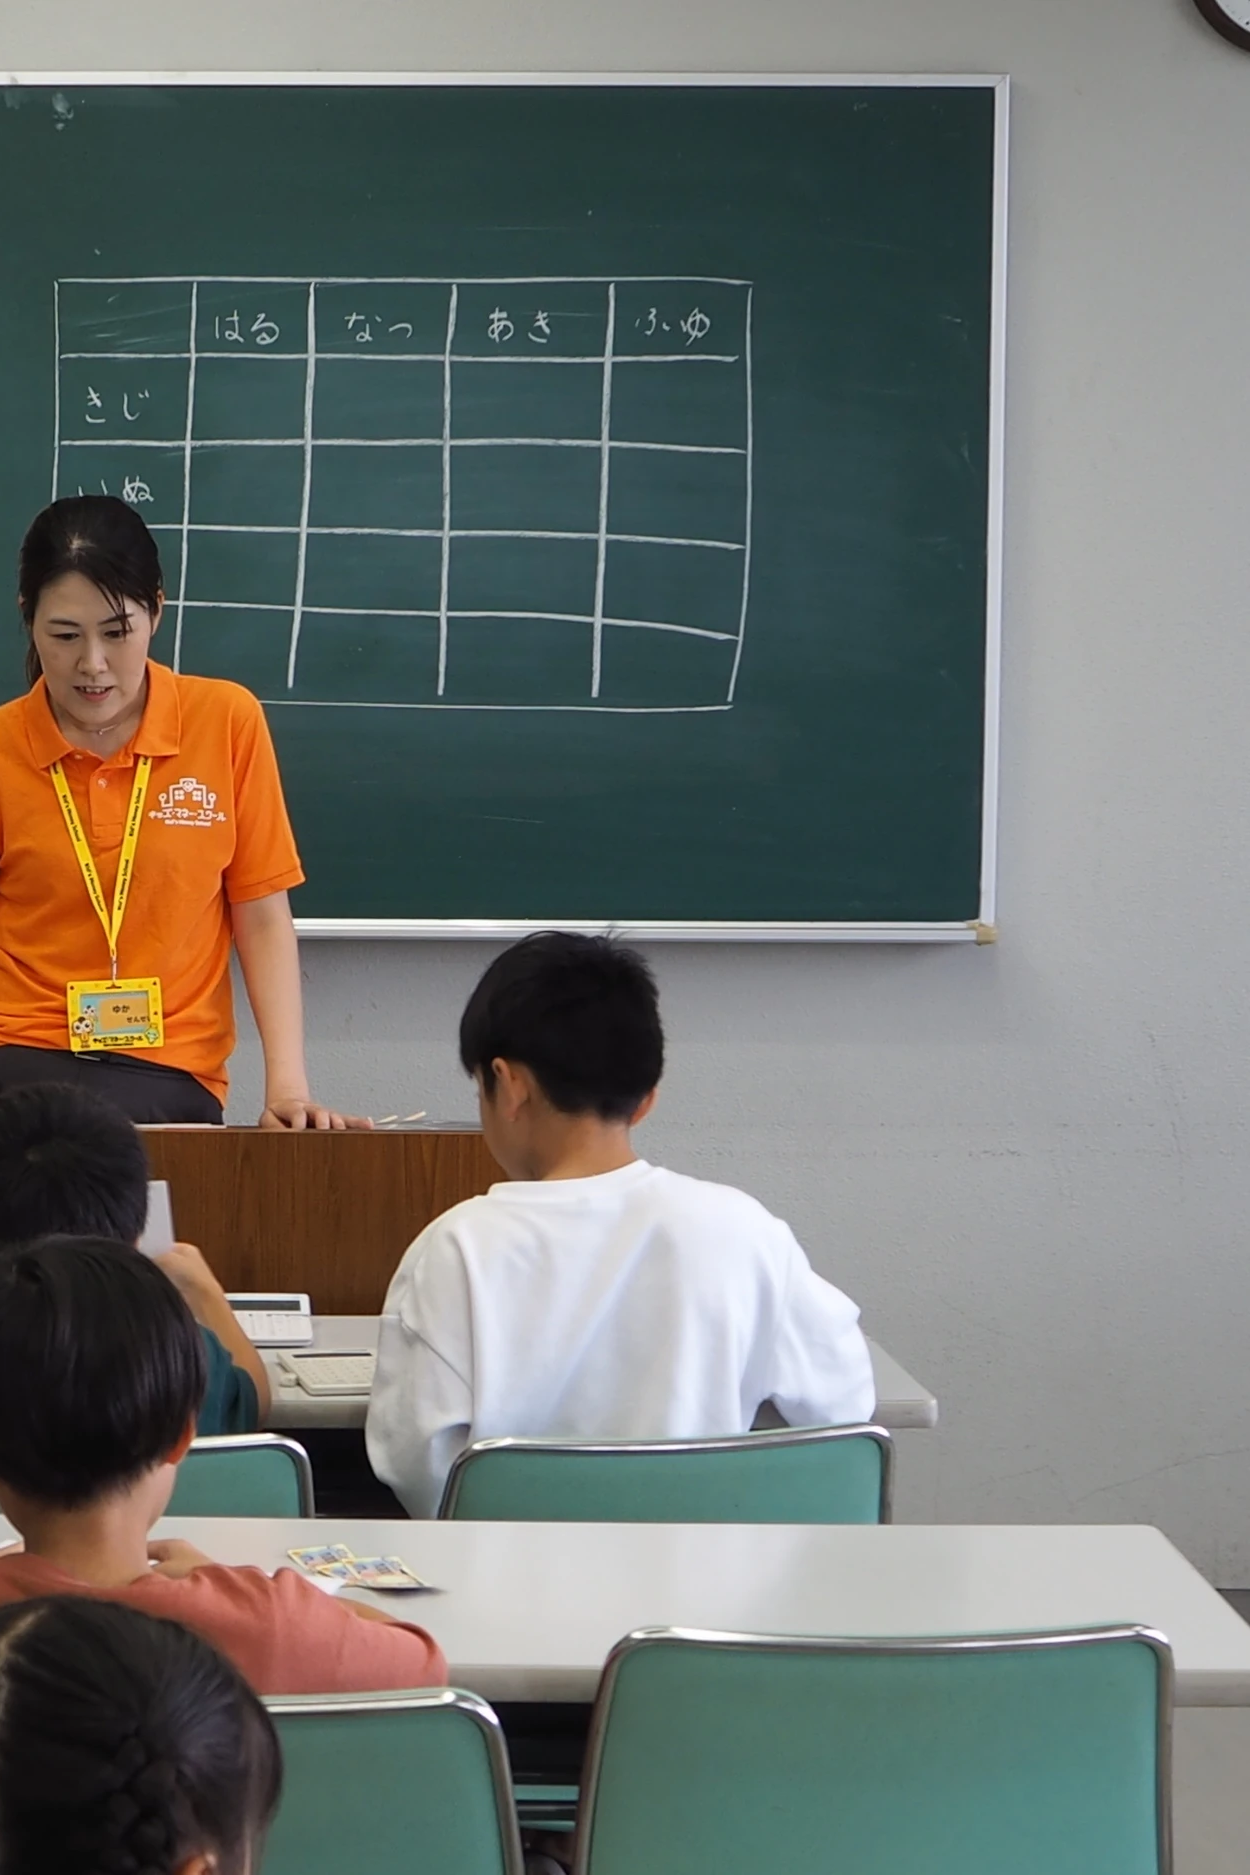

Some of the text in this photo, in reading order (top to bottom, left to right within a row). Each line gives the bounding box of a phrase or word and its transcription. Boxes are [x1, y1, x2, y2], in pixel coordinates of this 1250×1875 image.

[214, 307, 711, 346] はる なつ あき ふゆ
[83, 385, 151, 424] きじ
